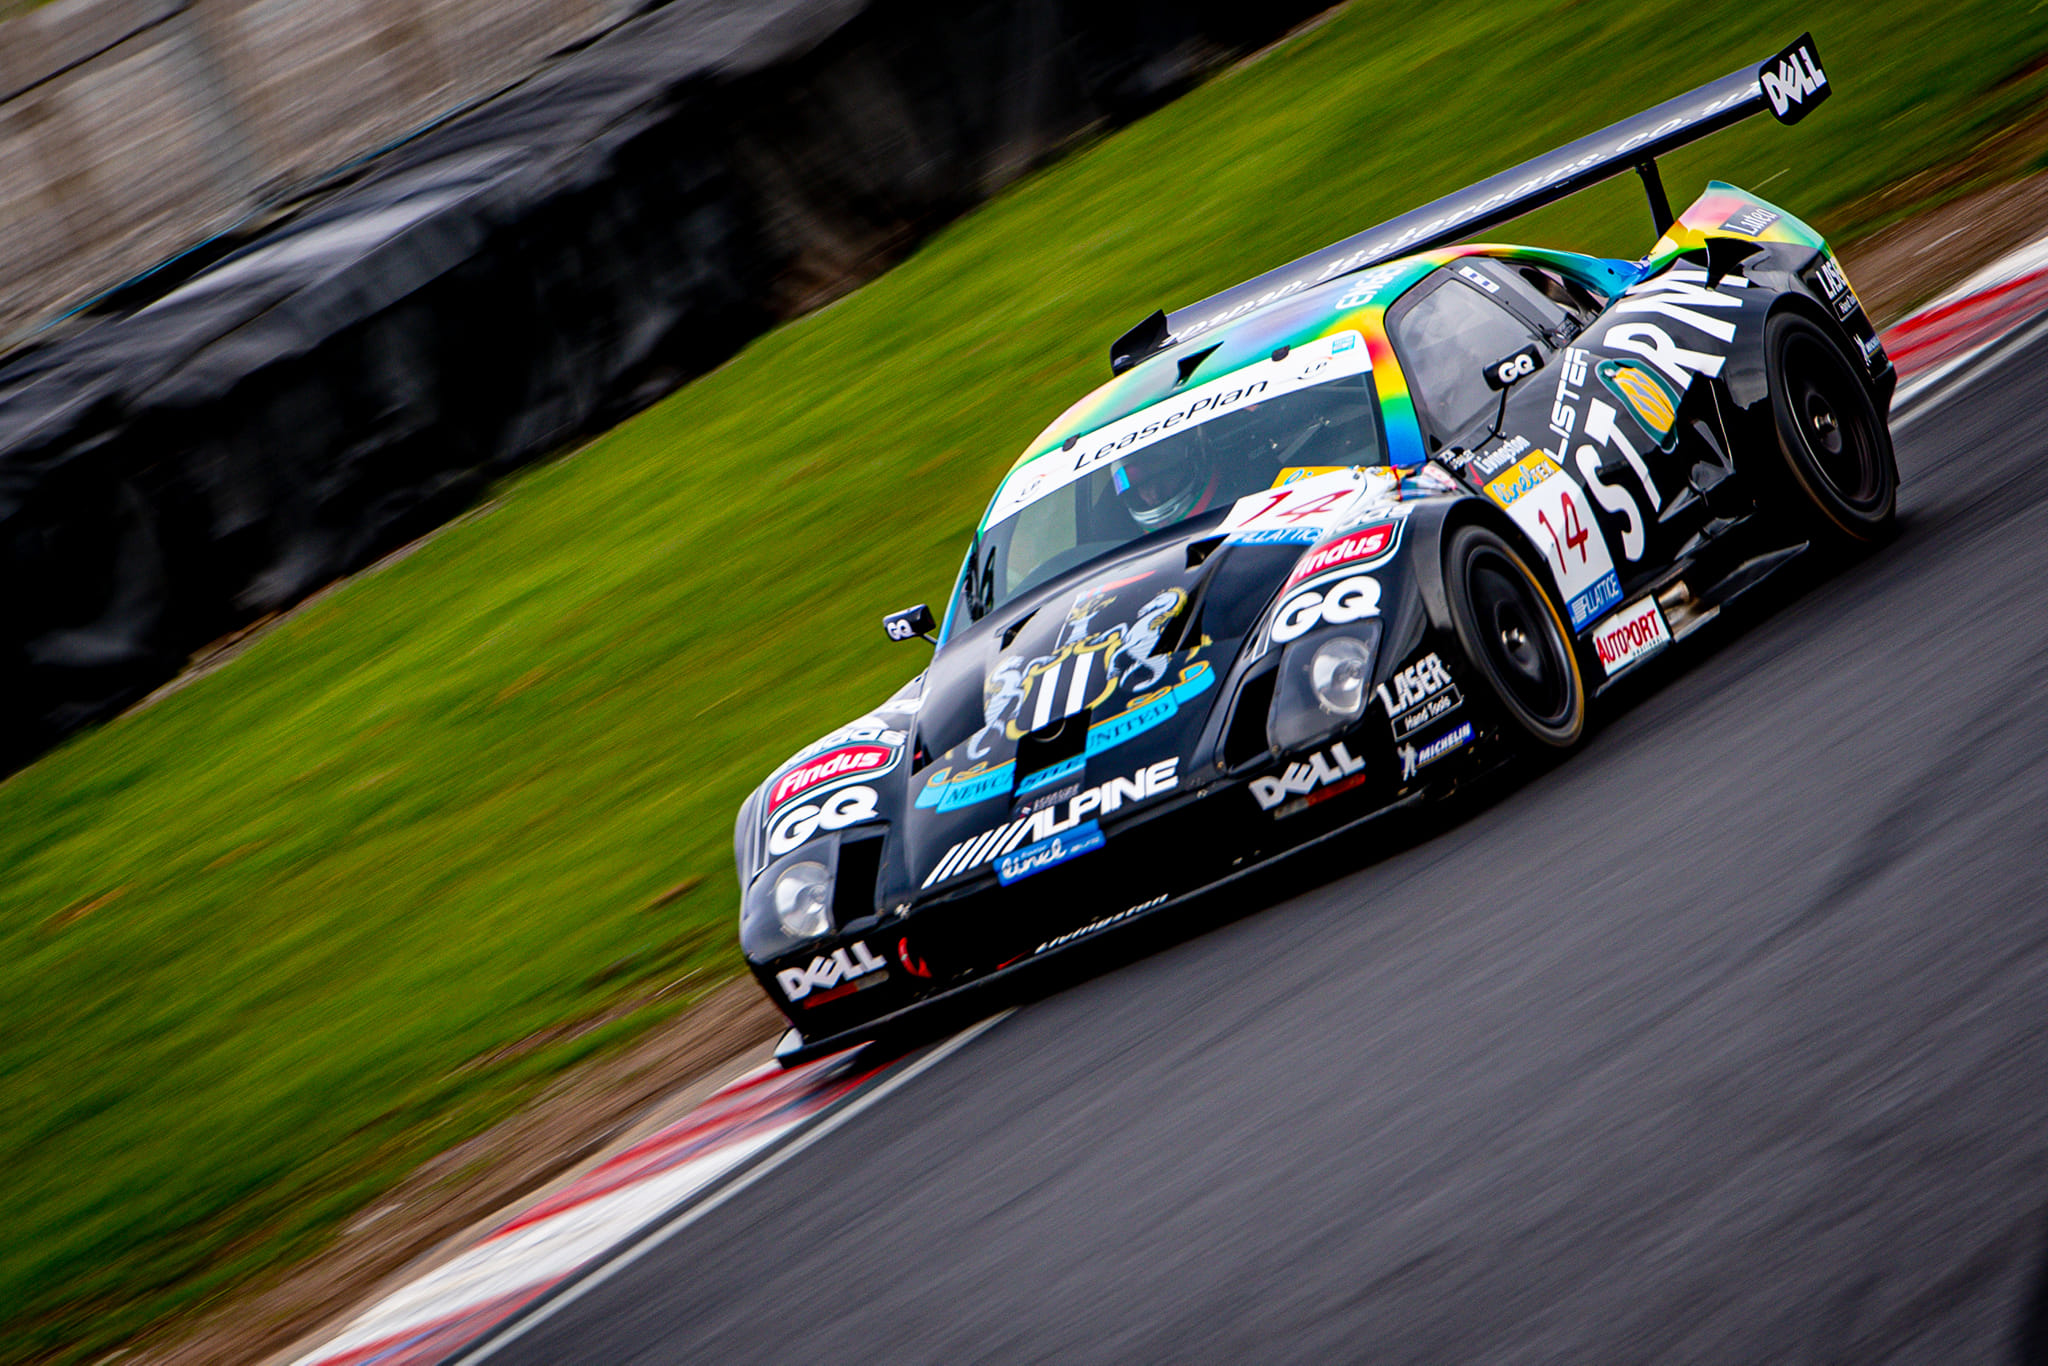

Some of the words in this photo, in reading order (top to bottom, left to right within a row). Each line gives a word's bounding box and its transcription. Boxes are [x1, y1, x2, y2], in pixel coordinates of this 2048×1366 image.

[1761, 46, 1826, 116] DELL
[1498, 354, 1535, 383] GQ
[1074, 380, 1268, 471] LeasePlan
[1238, 490, 1354, 529] 14
[1538, 491, 1588, 574] 14
[887, 619, 916, 641] GQ
[1272, 575, 1381, 643] GQ
[1376, 652, 1452, 718] LASER
[1248, 741, 1366, 811] DELL
[1419, 722, 1471, 764] MICHELIN
[775, 753, 882, 802] Findus
[1001, 757, 1178, 855] ALPINE
[770, 785, 879, 855] GQ
[776, 940, 887, 1002] DELL
